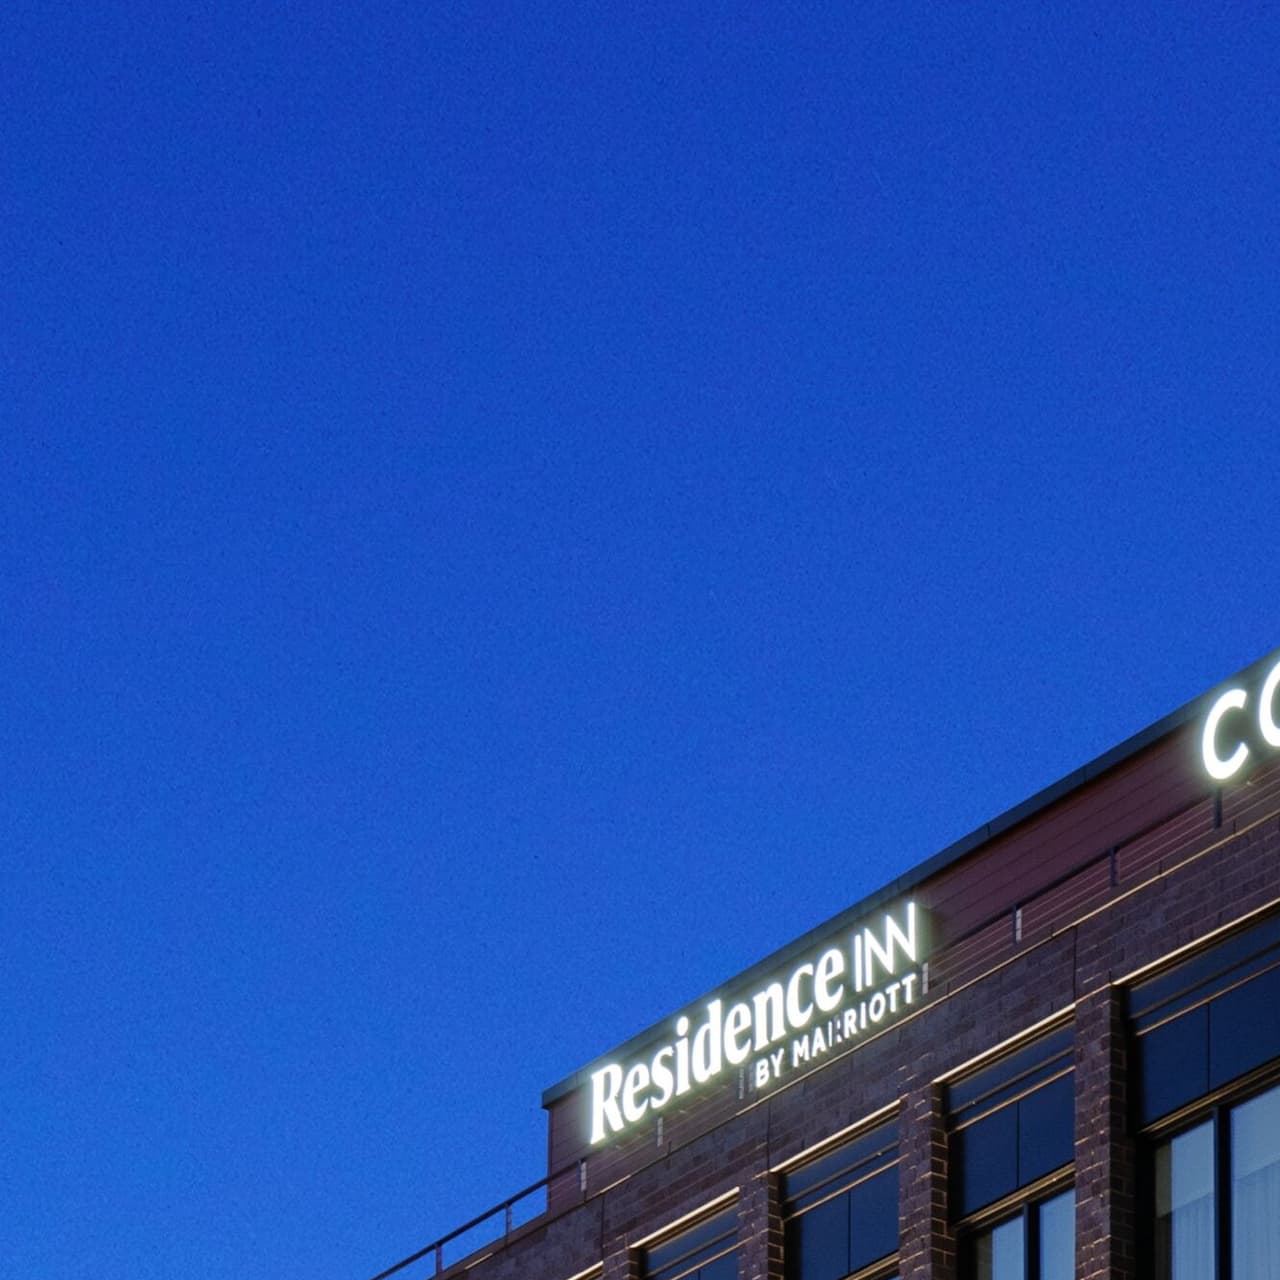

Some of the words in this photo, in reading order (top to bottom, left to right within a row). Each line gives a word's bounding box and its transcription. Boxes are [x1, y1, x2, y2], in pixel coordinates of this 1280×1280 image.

[588, 946, 846, 1146] Residence
[854, 901, 917, 993] INN
[755, 1047, 786, 1089] BY
